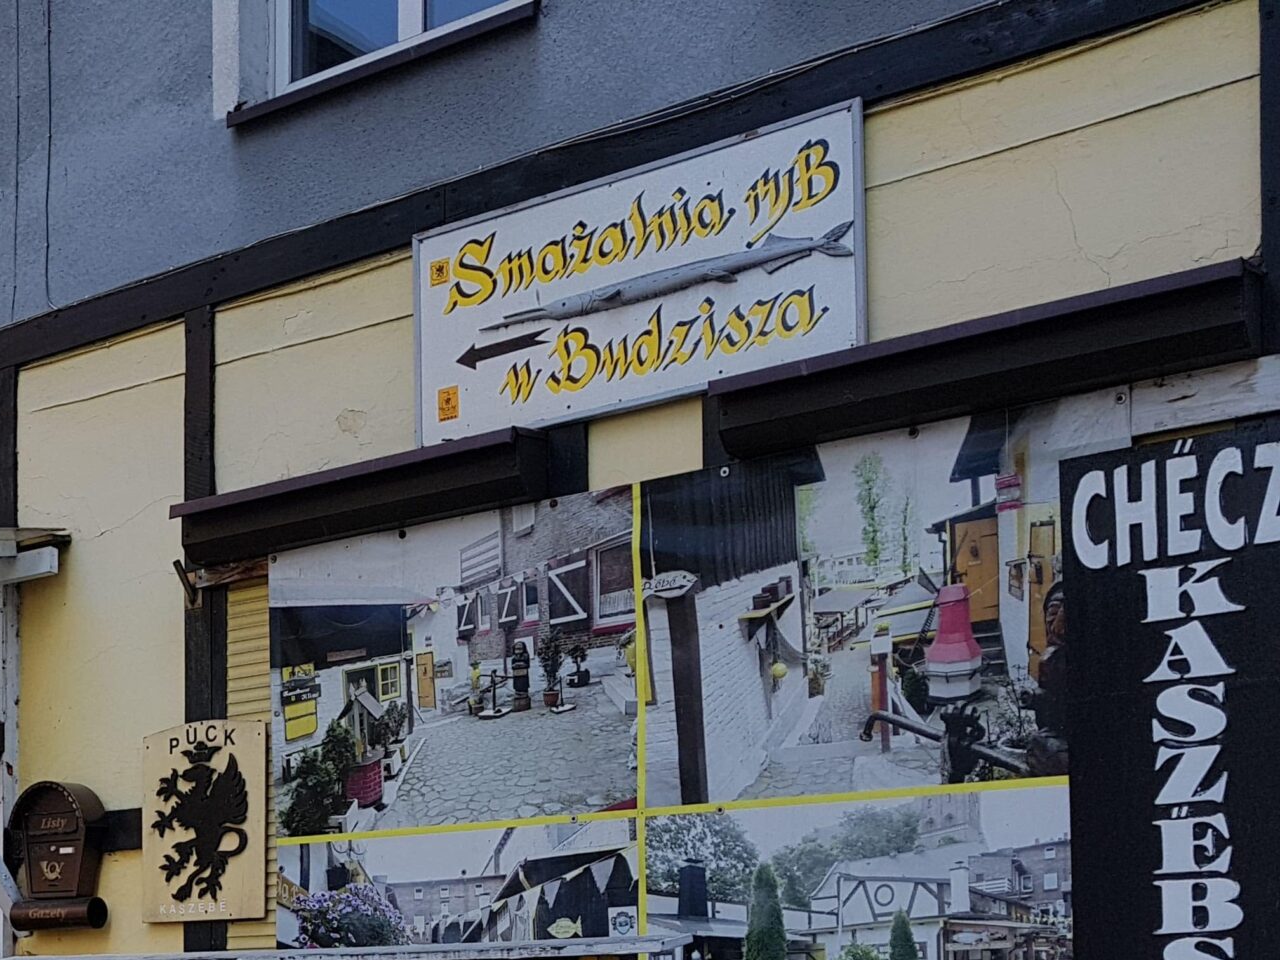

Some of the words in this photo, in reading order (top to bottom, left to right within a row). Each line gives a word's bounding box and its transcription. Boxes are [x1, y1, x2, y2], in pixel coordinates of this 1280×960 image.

[442, 187, 736, 314] Smażalnia
[546, 283, 830, 394] Budzisza
[41, 817, 68, 830] Listy
[29, 906, 68, 919] Gazety
